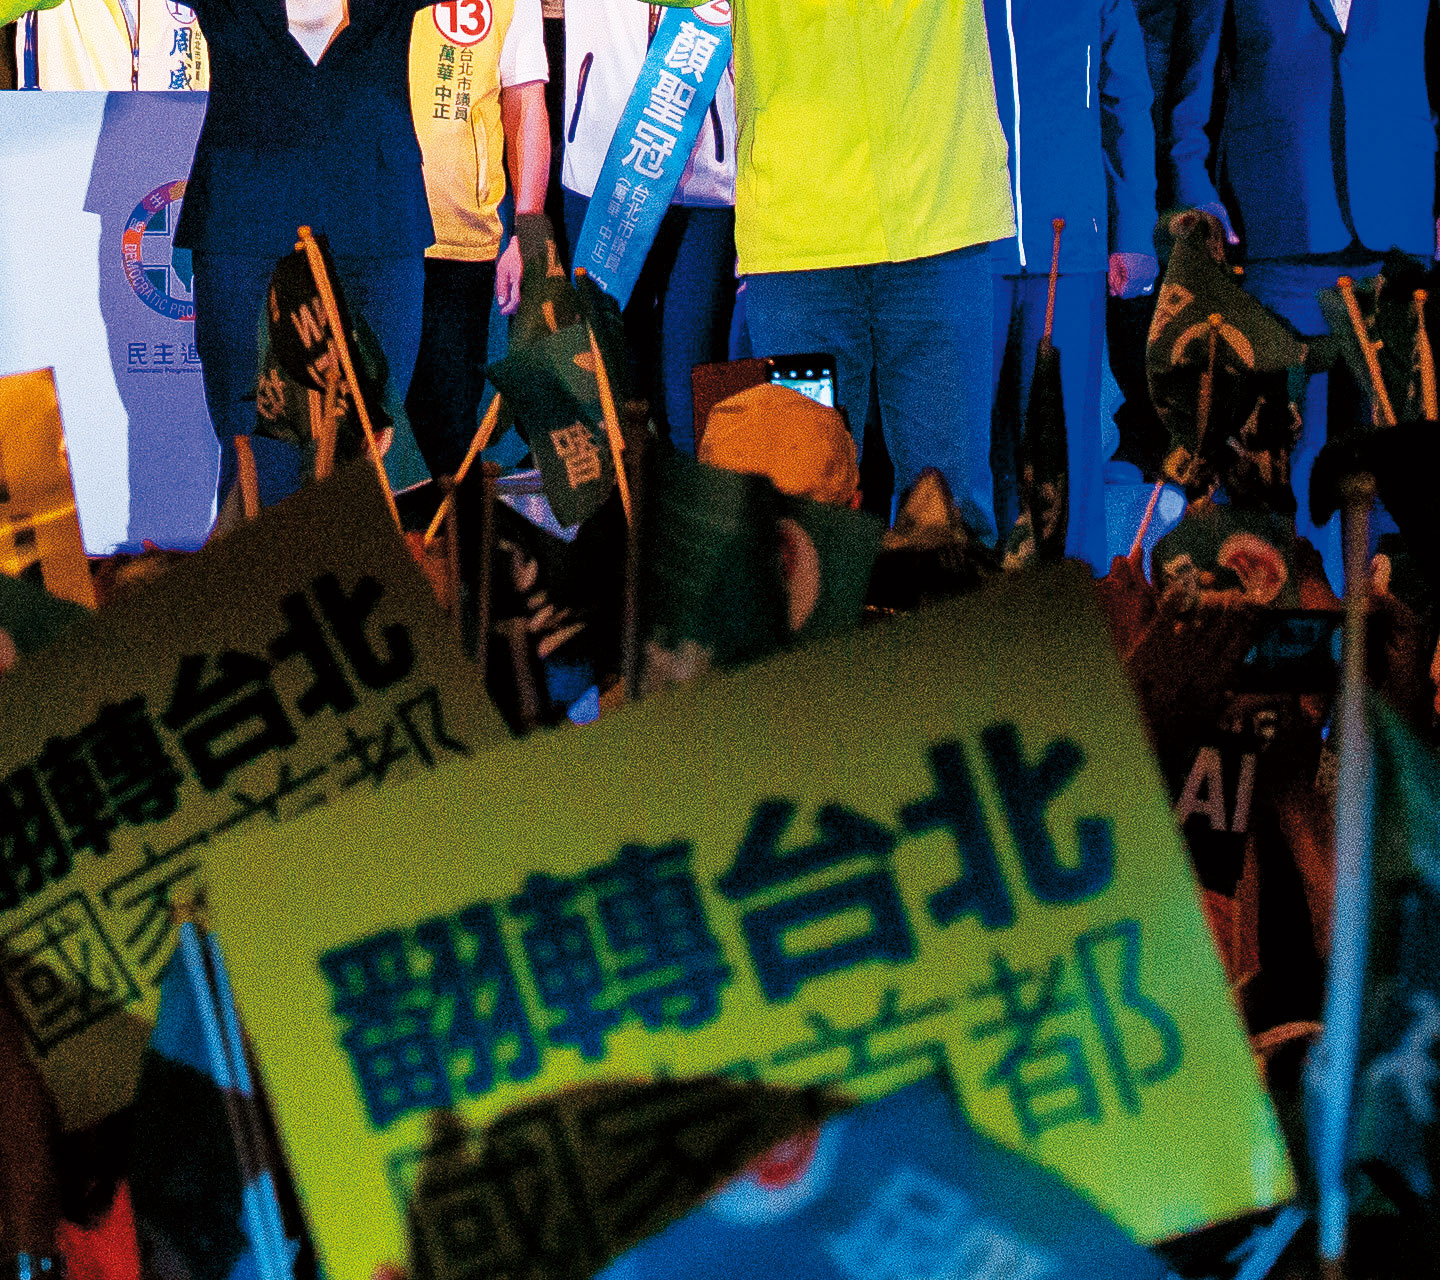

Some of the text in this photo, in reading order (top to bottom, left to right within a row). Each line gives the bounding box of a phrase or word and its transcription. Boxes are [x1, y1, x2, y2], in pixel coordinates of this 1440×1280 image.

[454, 47, 474, 122] 台北市議員
[127, 342, 202, 365] 民主進
[319, 723, 1116, 1129] 翻轉台北
